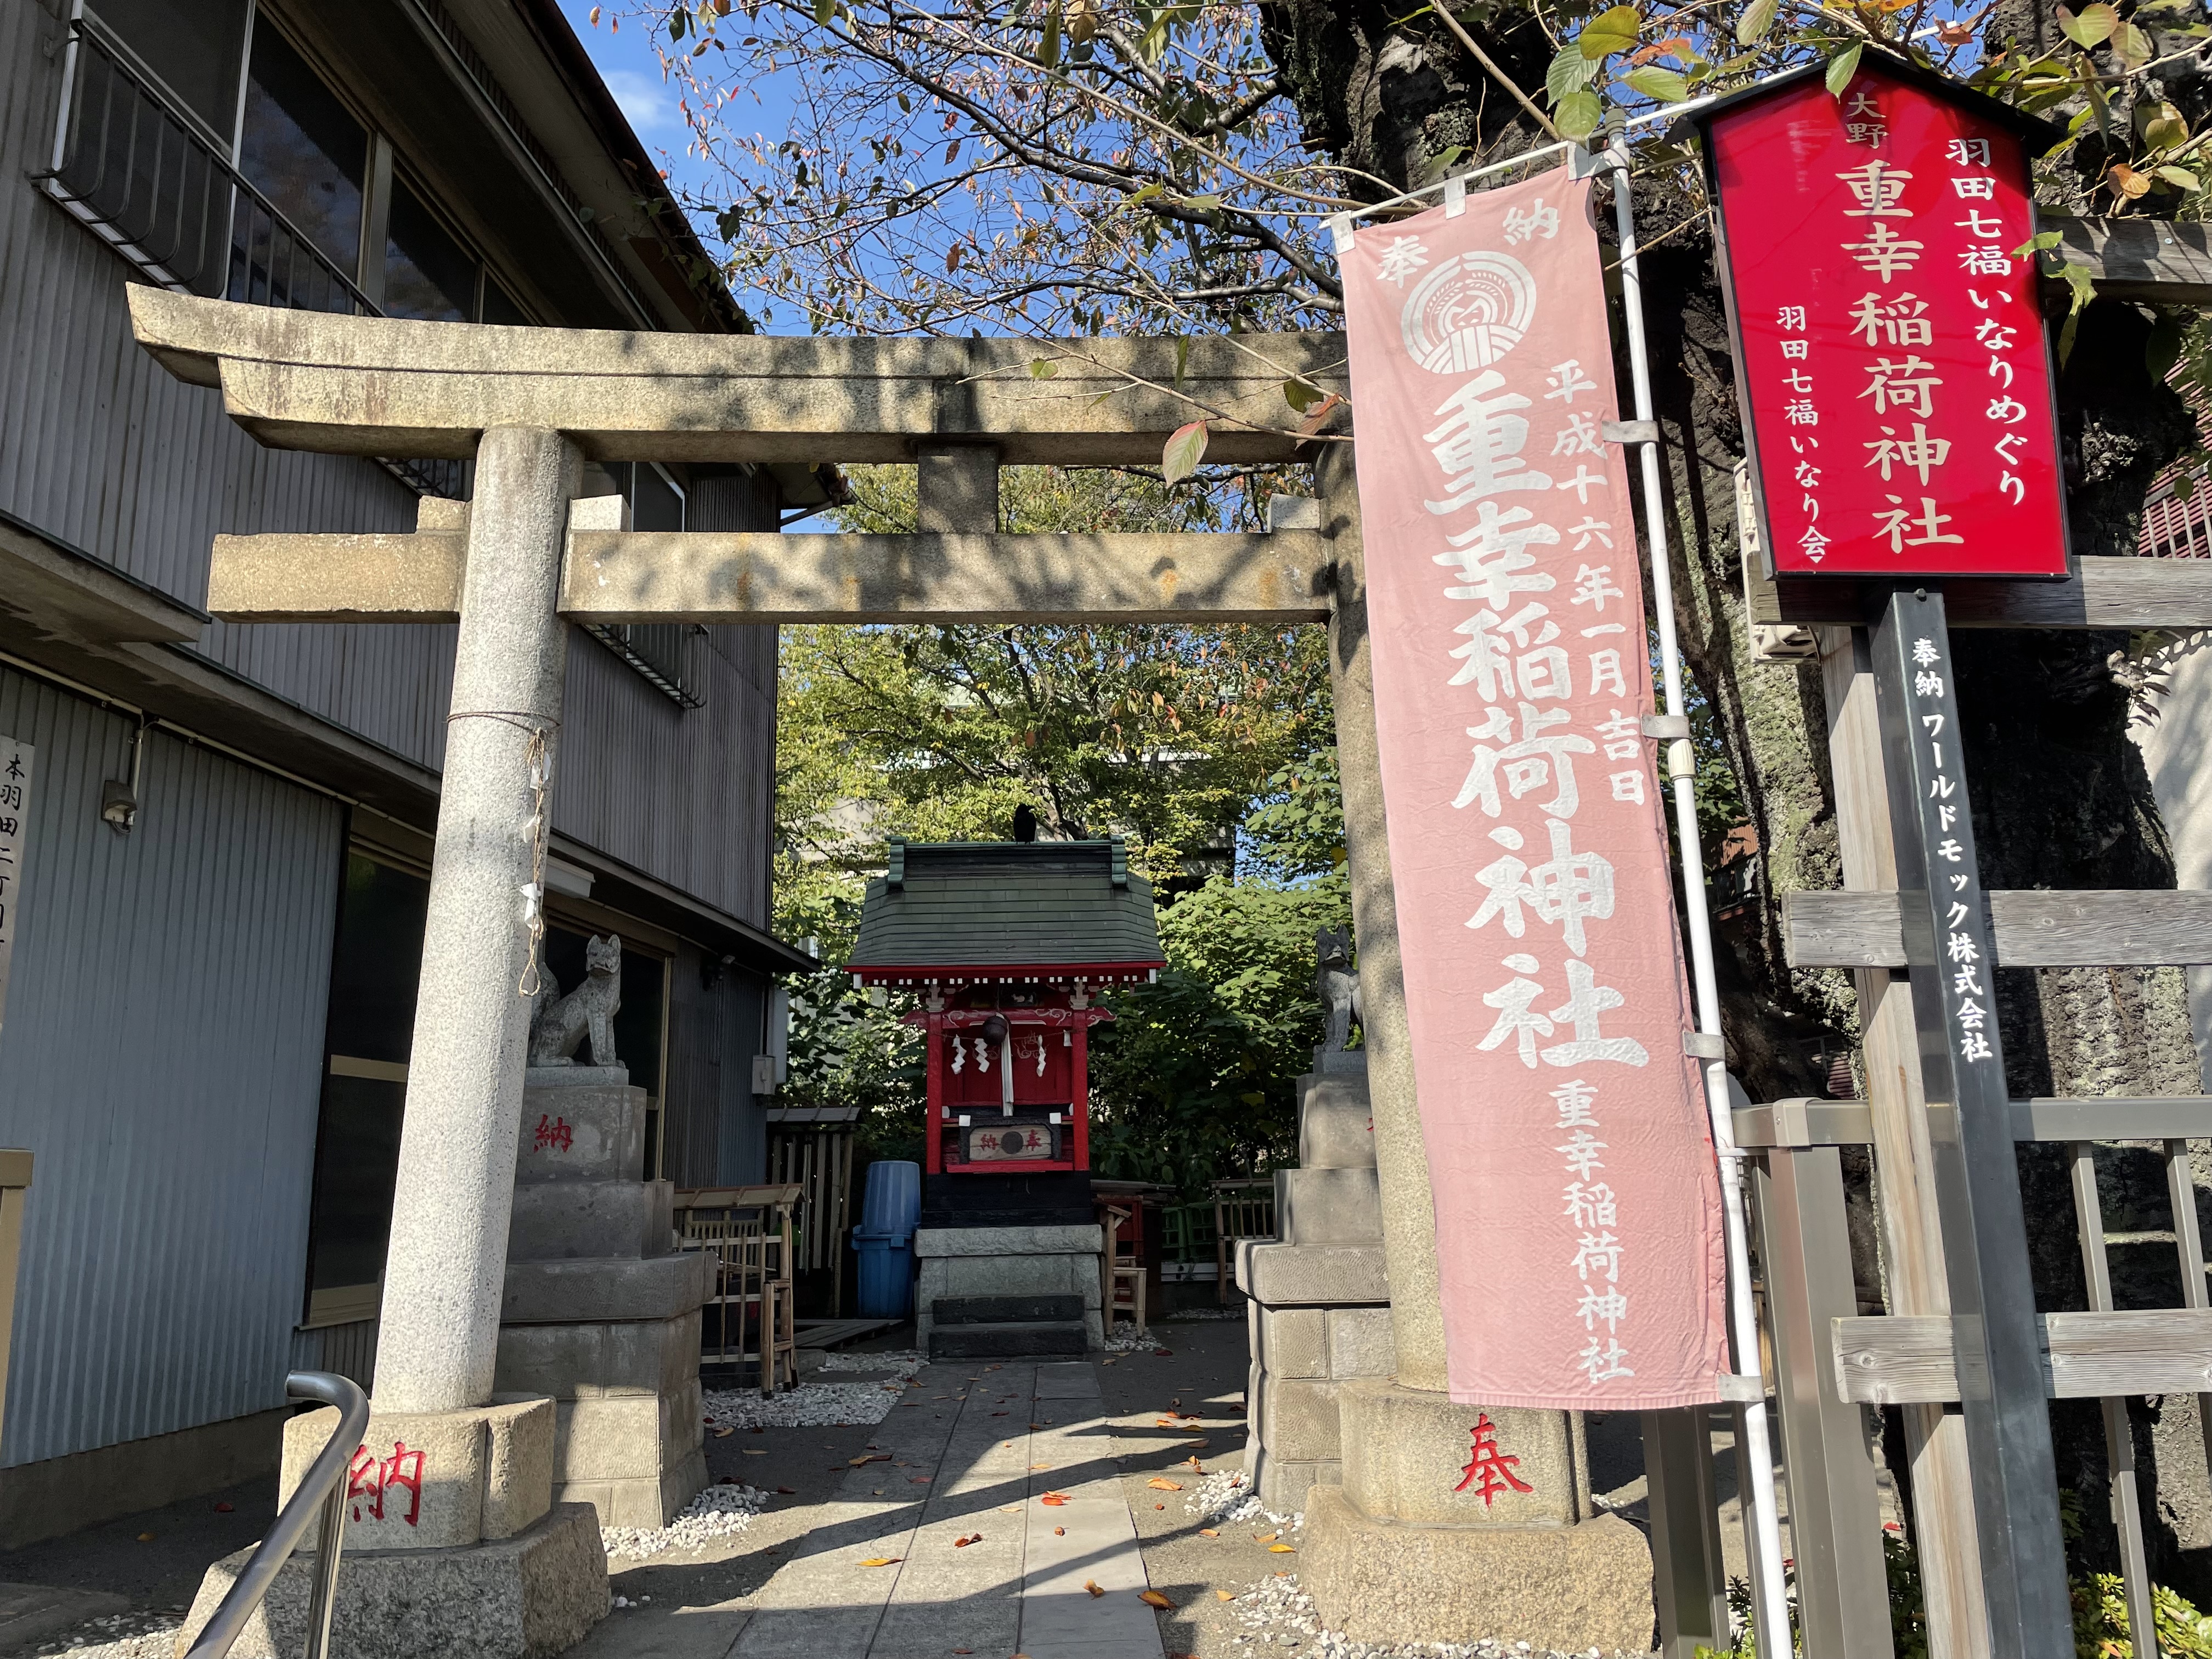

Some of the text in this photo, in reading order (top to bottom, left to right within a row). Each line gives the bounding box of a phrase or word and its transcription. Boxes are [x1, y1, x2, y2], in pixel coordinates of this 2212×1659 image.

[1775, 305, 1832, 556] 羽田七福いなり会
[1836, 92, 1964, 554] 大野 重幸稲荷神社
[1945, 138, 2028, 506] 羽田七福いなりめぐり
[1423, 369, 1649, 1069] 重幸稲荷神社
[1543, 359, 1645, 805] 平成十六年一月吉日
[1911, 637, 1993, 1063] 奉納 ワールドモック株式会社
[533, 1114, 573, 1153] 納
[1548, 1079, 1636, 1385] 重幸稲荷神社
[348, 1442, 426, 1527] 納
[1454, 1413, 1533, 1510] 奉
